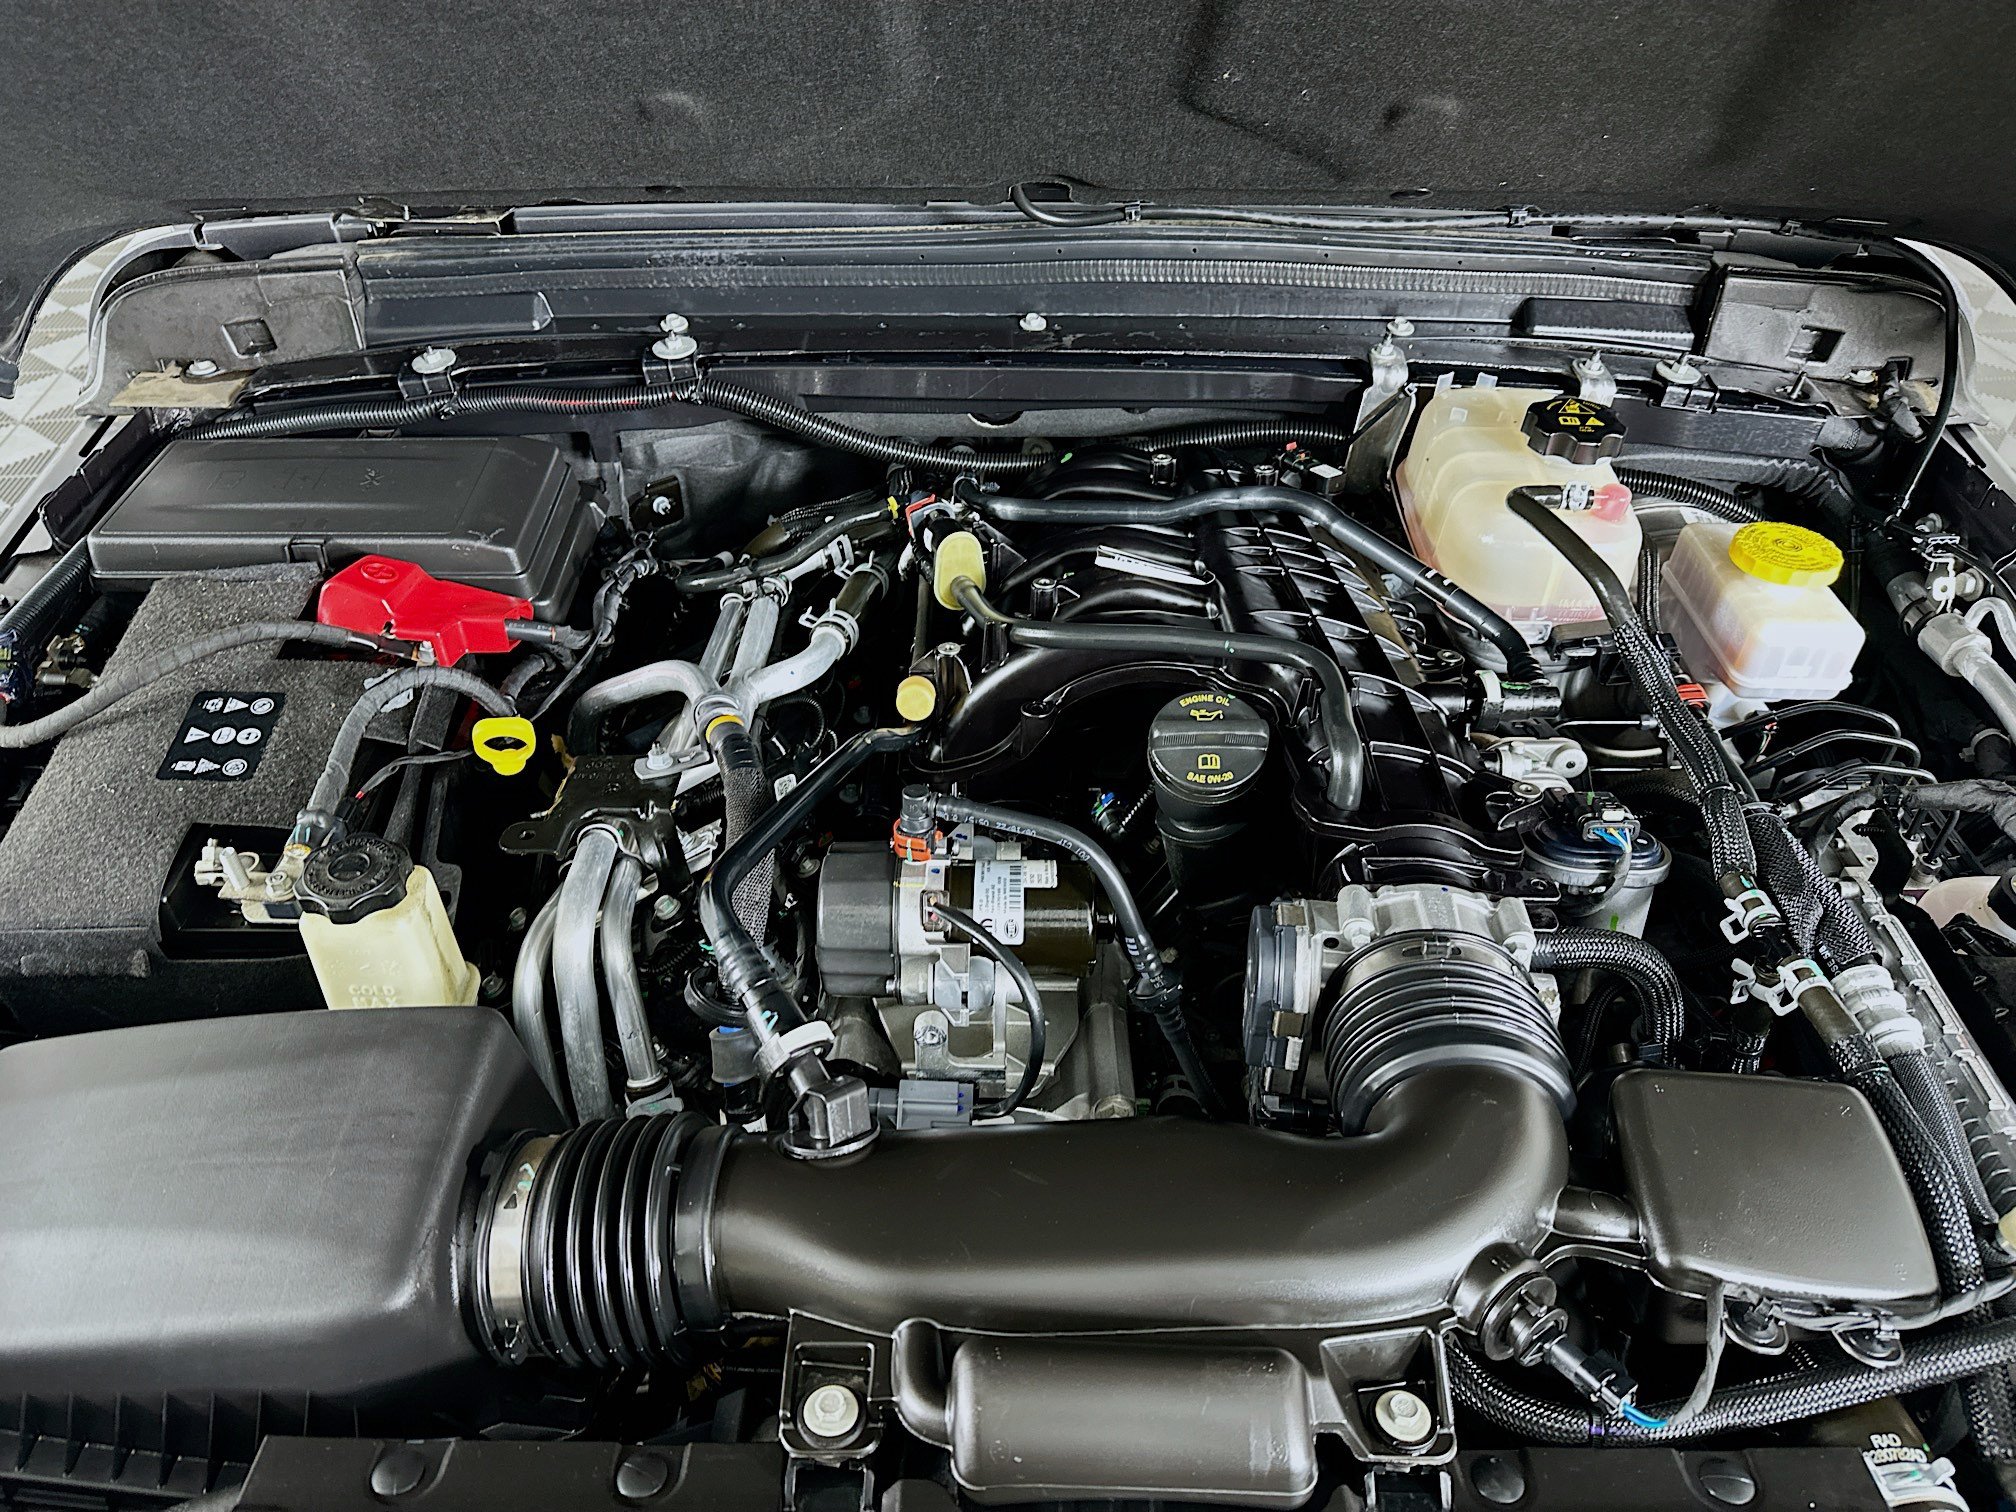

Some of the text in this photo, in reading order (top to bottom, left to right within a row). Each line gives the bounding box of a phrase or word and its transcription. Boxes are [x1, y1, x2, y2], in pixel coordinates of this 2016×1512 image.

[1179, 694, 1231, 707] ENGINE OIL
[1186, 771, 1234, 784] SAE 0W-20
[348, 983, 396, 996] COLD
[351, 995, 398, 1008] MAX
[1870, 1433, 1902, 1448] RAD
